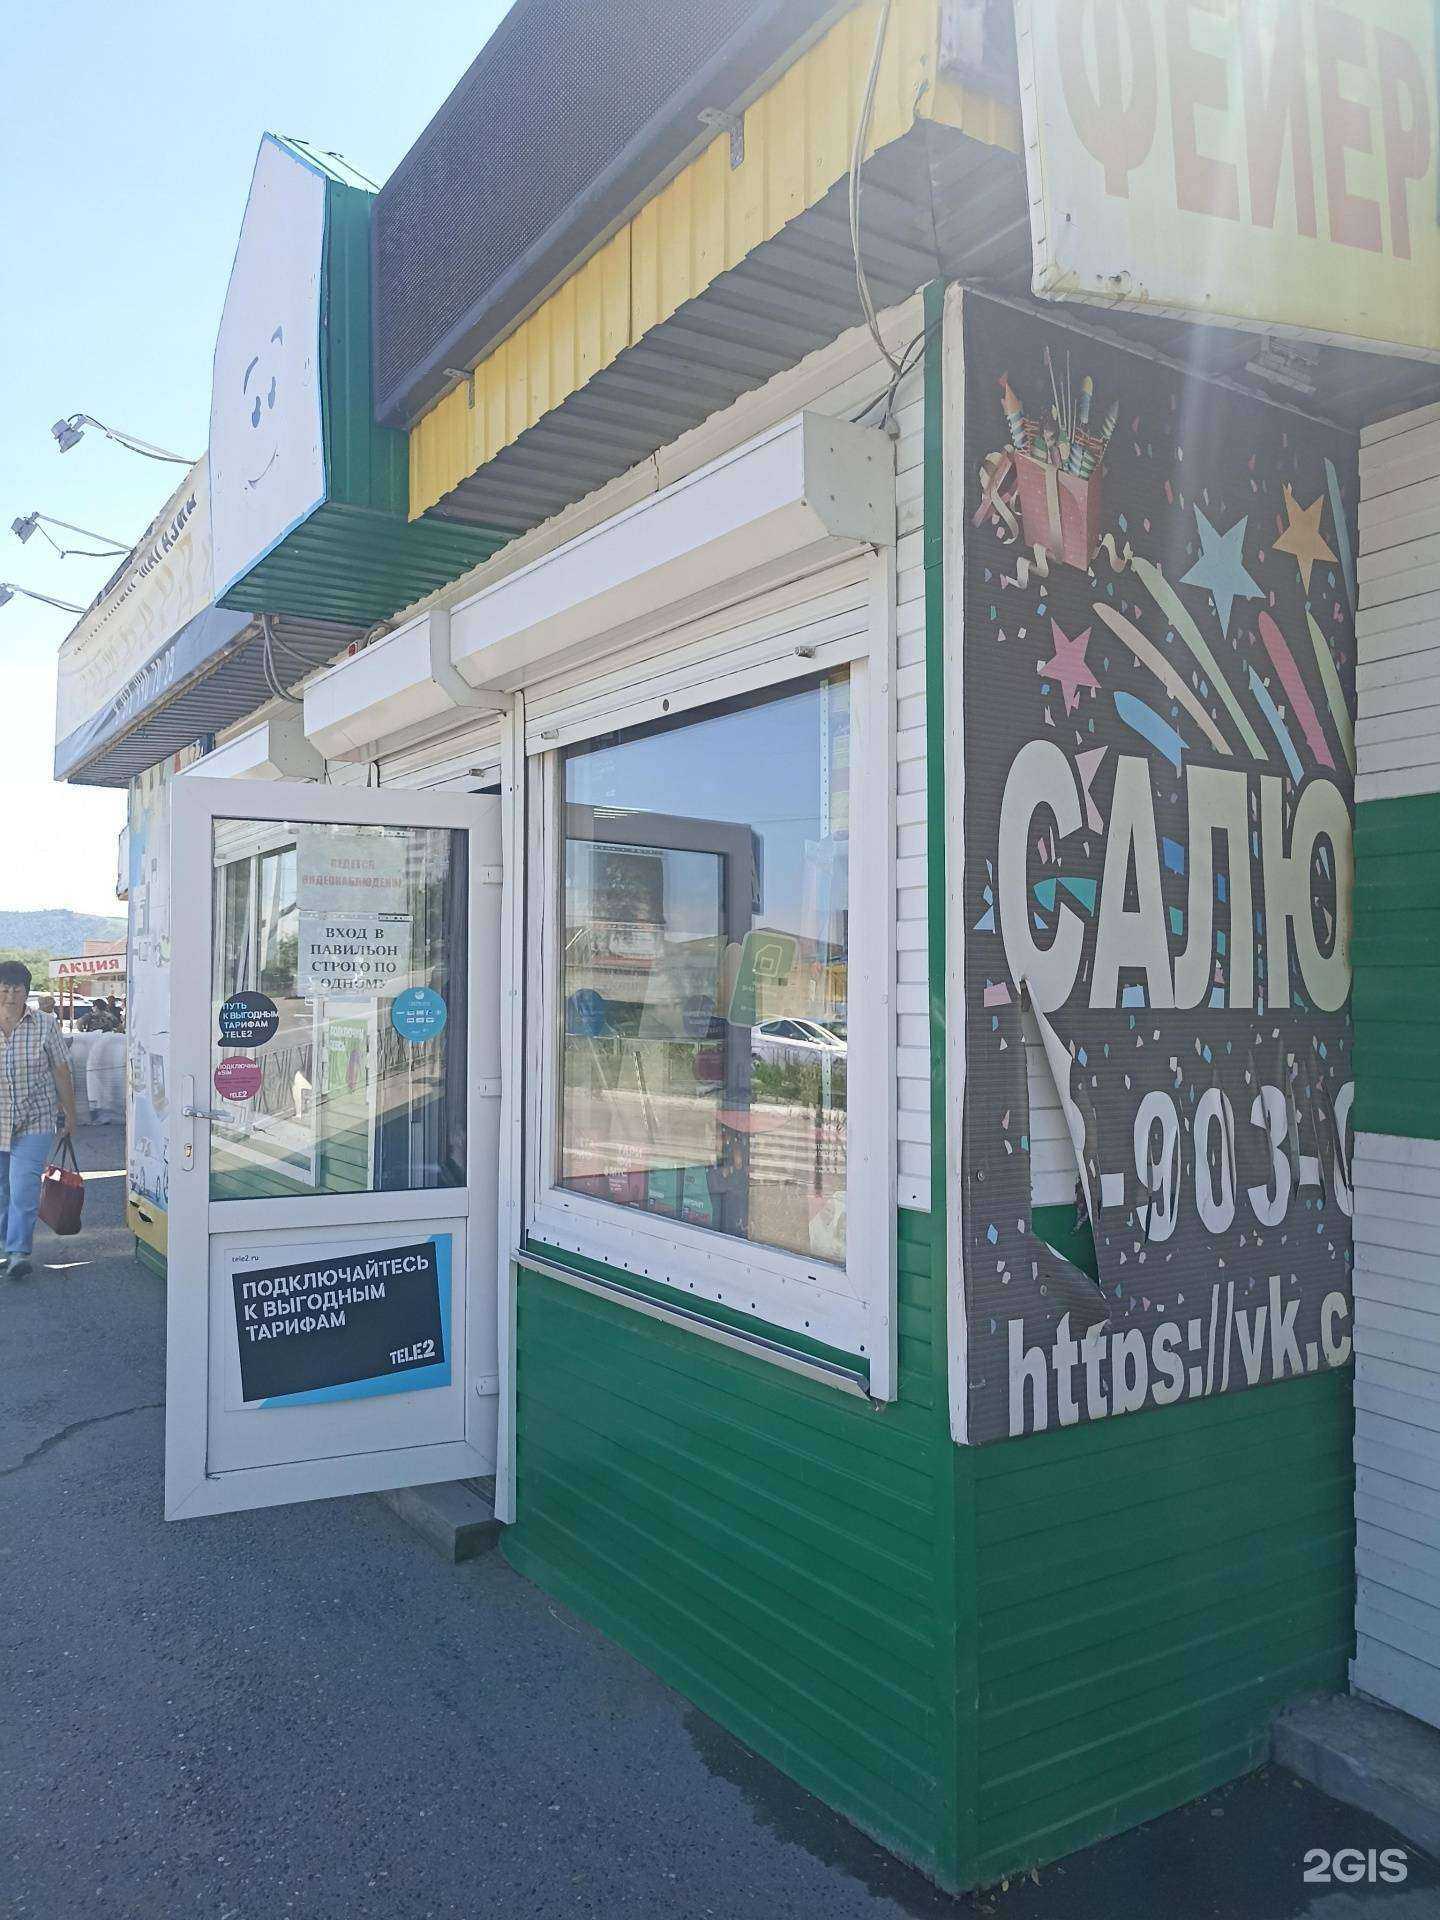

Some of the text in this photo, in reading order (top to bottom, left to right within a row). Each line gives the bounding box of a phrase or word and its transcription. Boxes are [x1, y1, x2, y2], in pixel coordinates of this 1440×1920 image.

[325, 927, 384, 940] ВХОД В
[310, 944, 398, 956] ПАВИЛЬОН
[58, 958, 119, 975] АКЦИЯ
[311, 961, 397, 973] СТРОГО ПО
[222, 1002, 247, 1011] ПУТЬ
[222, 1010, 279, 1021] К ВЫГОДНЫМ
[223, 1020, 269, 1029] ТАРИФАМ
[224, 1030, 253, 1039] TELE2
[242, 1255, 429, 1300] ПОДКЛЮЧАЙТЕСЬ
[244, 1282, 386, 1321] К ВЫГОДНЫМ
[245, 1310, 346, 1342] ТАРИФАМ
[389, 1339, 435, 1365] TELE2
